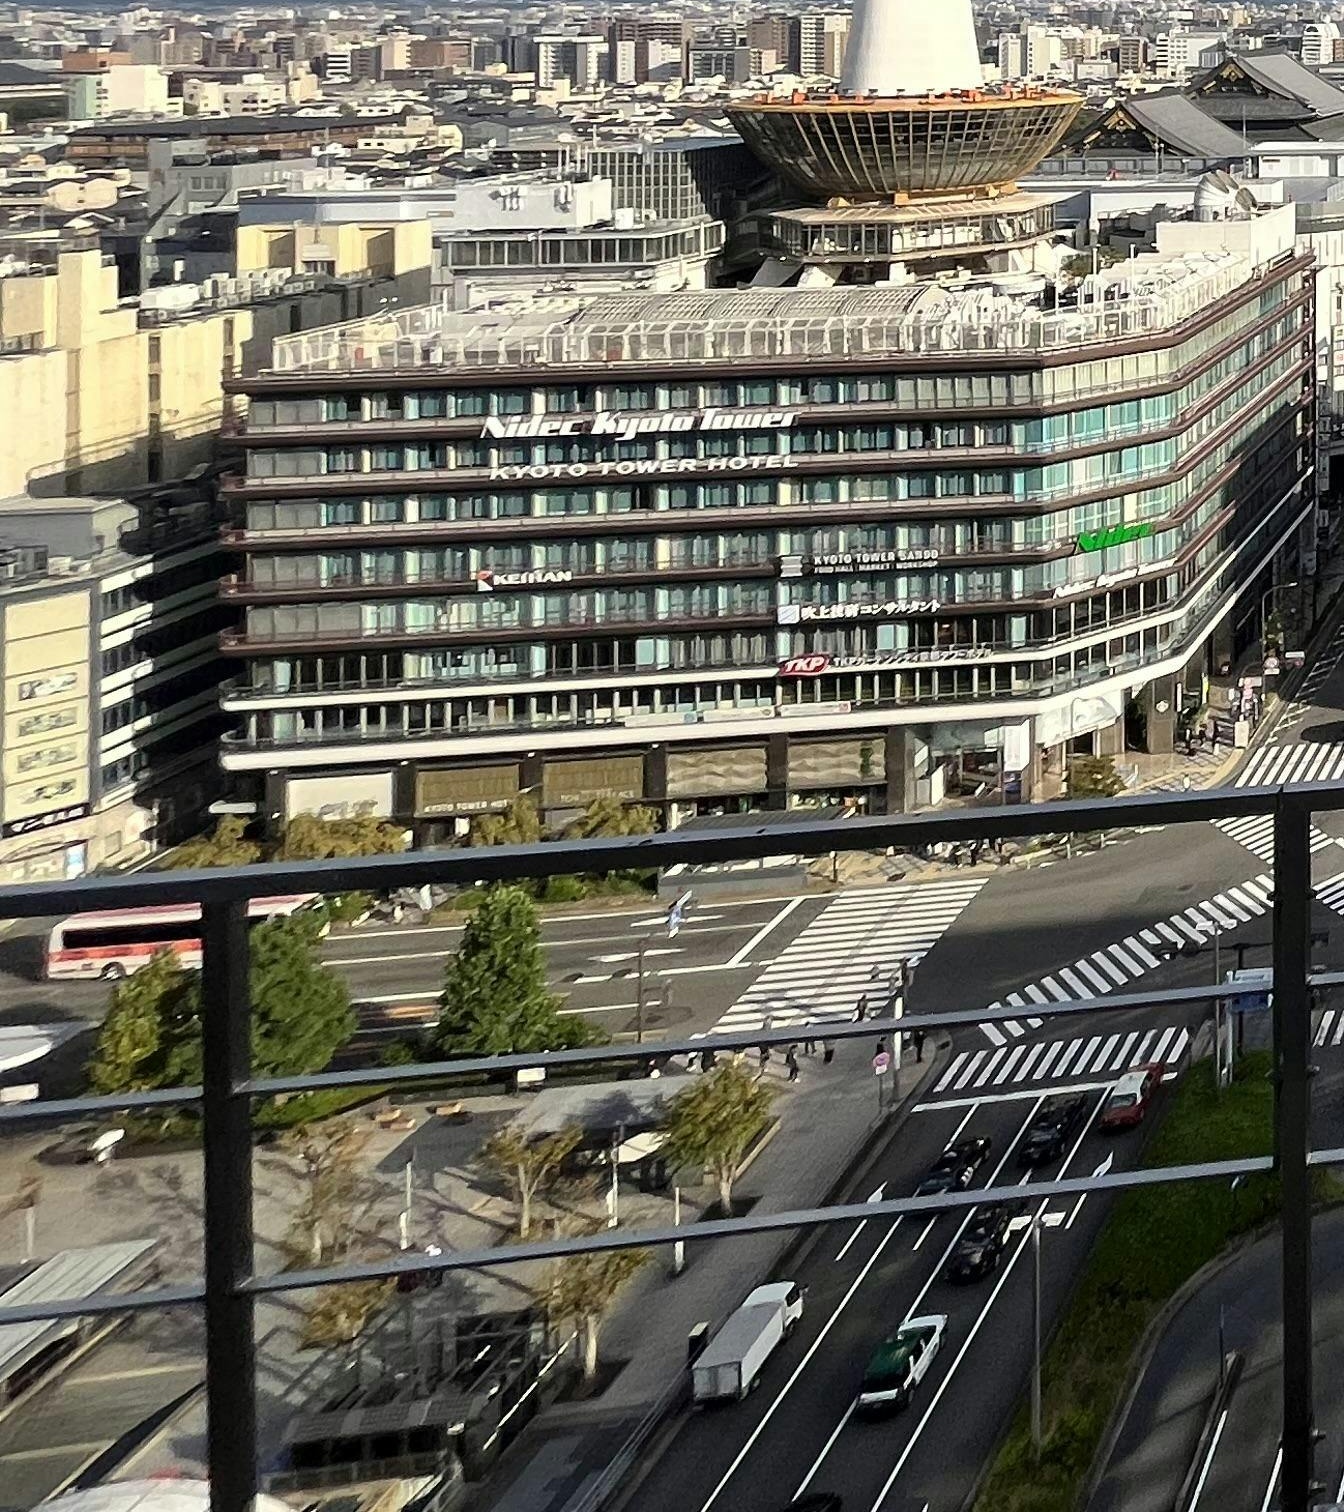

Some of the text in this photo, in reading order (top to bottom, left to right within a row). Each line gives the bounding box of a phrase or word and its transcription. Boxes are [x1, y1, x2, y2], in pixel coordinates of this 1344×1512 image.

[480, 407, 802, 441] Nidec Kyoto Tower
[489, 454, 800, 481] KYOTO TOWER HOTEL
[814, 554, 852, 566] KYOTO
[856, 551, 896, 563] TOWER
[493, 569, 573, 586] KEIHAN
[785, 657, 825, 674] TKP
